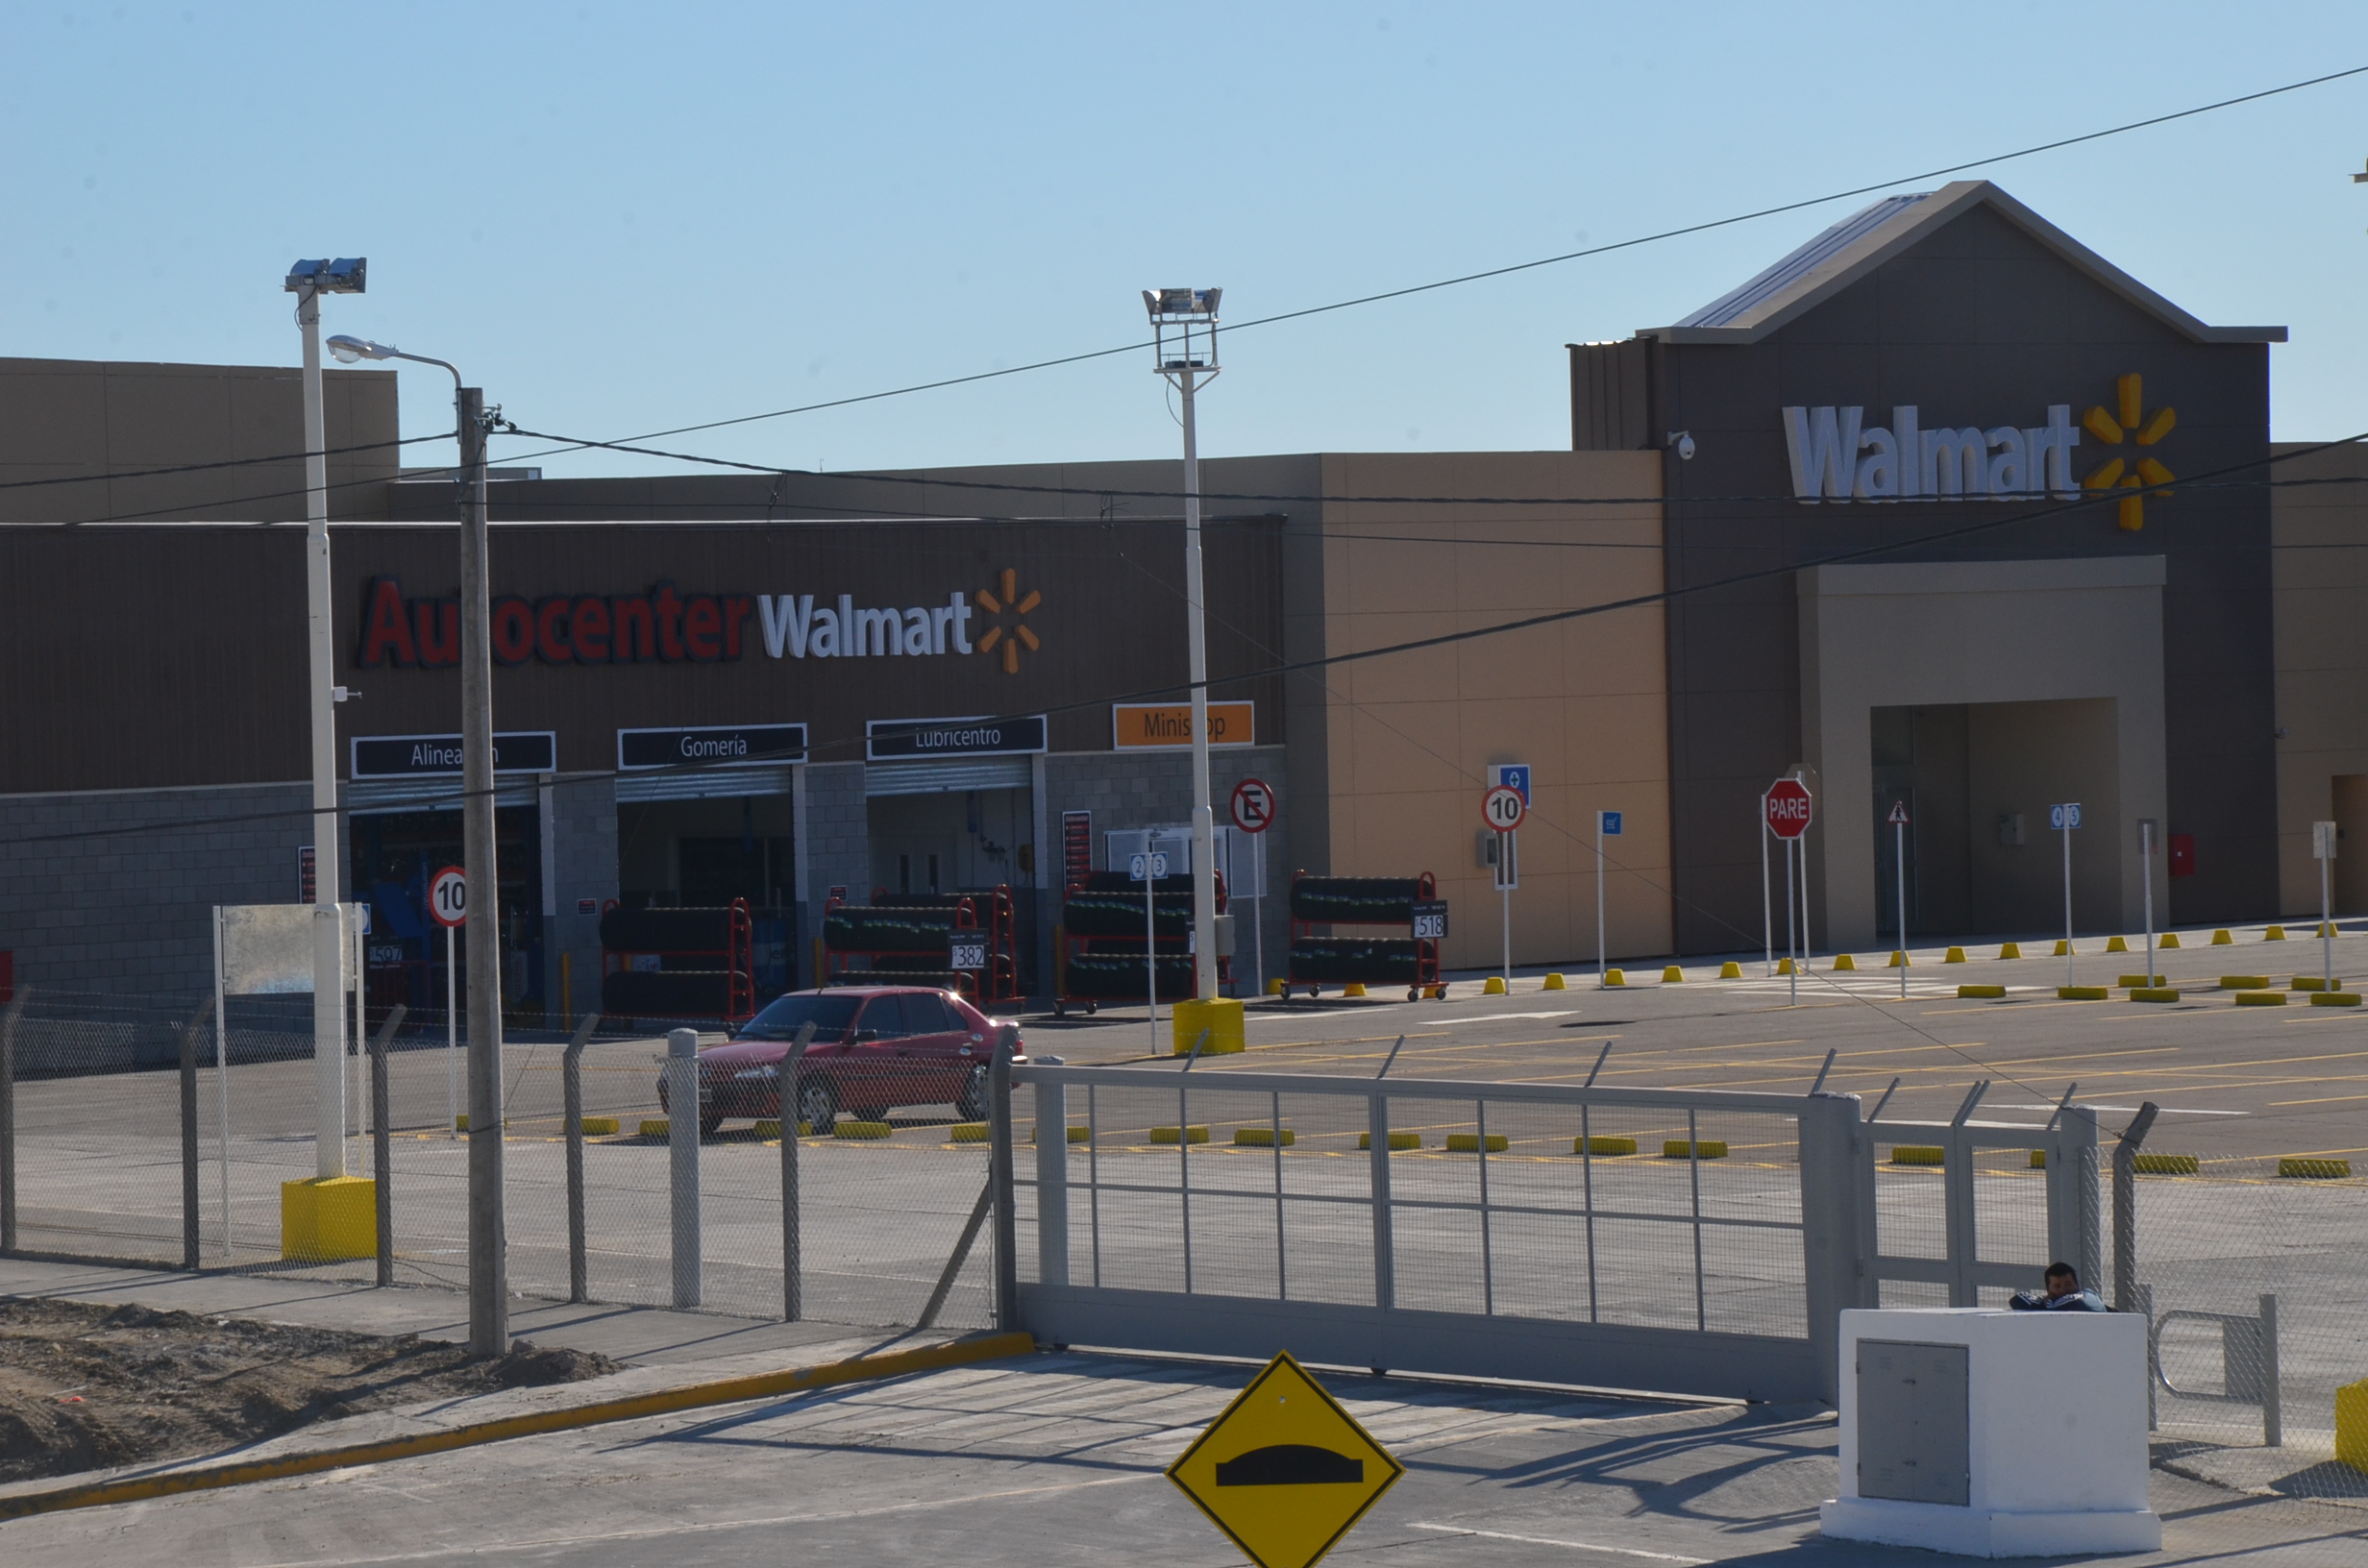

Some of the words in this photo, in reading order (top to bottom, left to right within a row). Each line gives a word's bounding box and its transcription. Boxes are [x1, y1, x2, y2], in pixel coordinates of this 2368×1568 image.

[1783, 404, 2081, 504] Walmart
[363, 577, 751, 667] Auocenter
[757, 592, 973, 658] Walmart
[916, 727, 1000, 747] Lubricentro
[1145, 713, 1225, 742] Minisop
[411, 743, 499, 766] Alinean
[680, 734, 747, 757] Gomería
[1492, 796, 1518, 820] 10
[1769, 797, 1808, 820] PARE
[1136, 861, 1142, 873] 2
[1156, 859, 1162, 871] 3
[437, 881, 465, 911] 10
